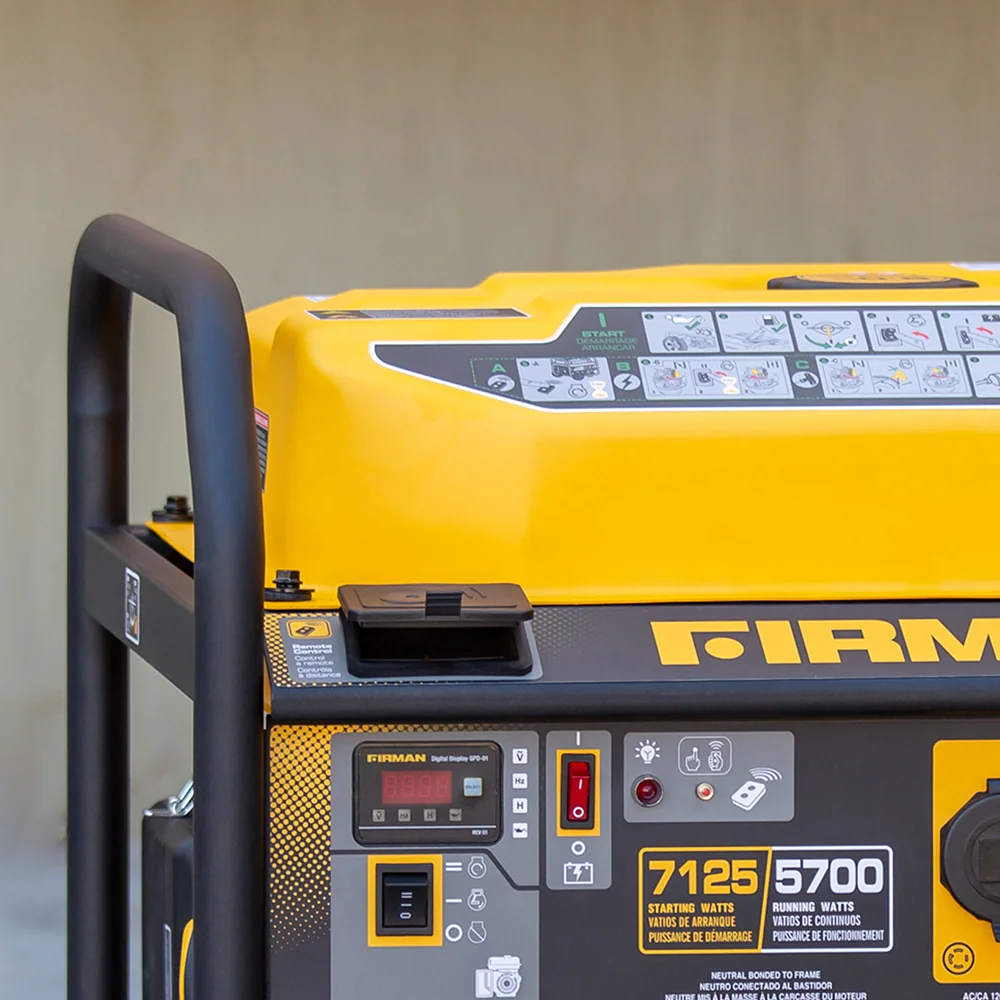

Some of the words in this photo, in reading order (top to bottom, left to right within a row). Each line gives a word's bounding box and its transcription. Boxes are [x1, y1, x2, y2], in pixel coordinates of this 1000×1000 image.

[582, 330, 625, 338] START
[491, 363, 507, 373] A
[616, 362, 631, 371] B
[795, 360, 809, 370] C
[367, 754, 426, 763] FIRMAN
[430, 755, 448, 763] Digital
[449, 755, 468, 763] Display
[515, 776, 525, 785] Hz
[516, 801, 524, 810] H
[648, 859, 758, 895] 7125
[774, 858, 884, 894] 5700
[648, 903, 696, 914] STARTING
[701, 902, 735, 913] WATTS
[772, 901, 816, 912] RUNNING
[821, 901, 855, 912] WATTS
[648, 916, 677, 928] VATIOS
[678, 916, 690, 927] DE
[691, 915, 736, 927] ARRANQUE
[772, 915, 801, 927] VATIOS
[801, 915, 813, 926] DE
[815, 914, 861, 926] CONTINUOS
[648, 931, 692, 943] PUISSANCE
[693, 931, 704, 942] DE
[705, 929, 753, 942] DÉMARRAGE
[772, 930, 811, 941] PUISSANCE
[812, 930, 822, 941] DE
[822, 929, 884, 941] FONCTIONNEMENT
[711, 971, 747, 980] NEUTRAL
[748, 971, 781, 979] BONDED
[781, 971, 793, 979] TO
[794, 970, 821, 979] FRAME
[699, 982, 731, 991] NEUTRO
[732, 982, 780, 991] CONECTADO
[782, 982, 793, 990] AL
[794, 981, 833, 990] BASTIDOR
[759, 992, 766, 1000] À
[767, 993, 778, 1000] LA
[778, 993, 821, 1000] CARCASSE
[822, 993, 833, 1000] DU
[834, 992, 867, 1000] MOTEUR
[963, 991, 989, 1000] AC/CA
